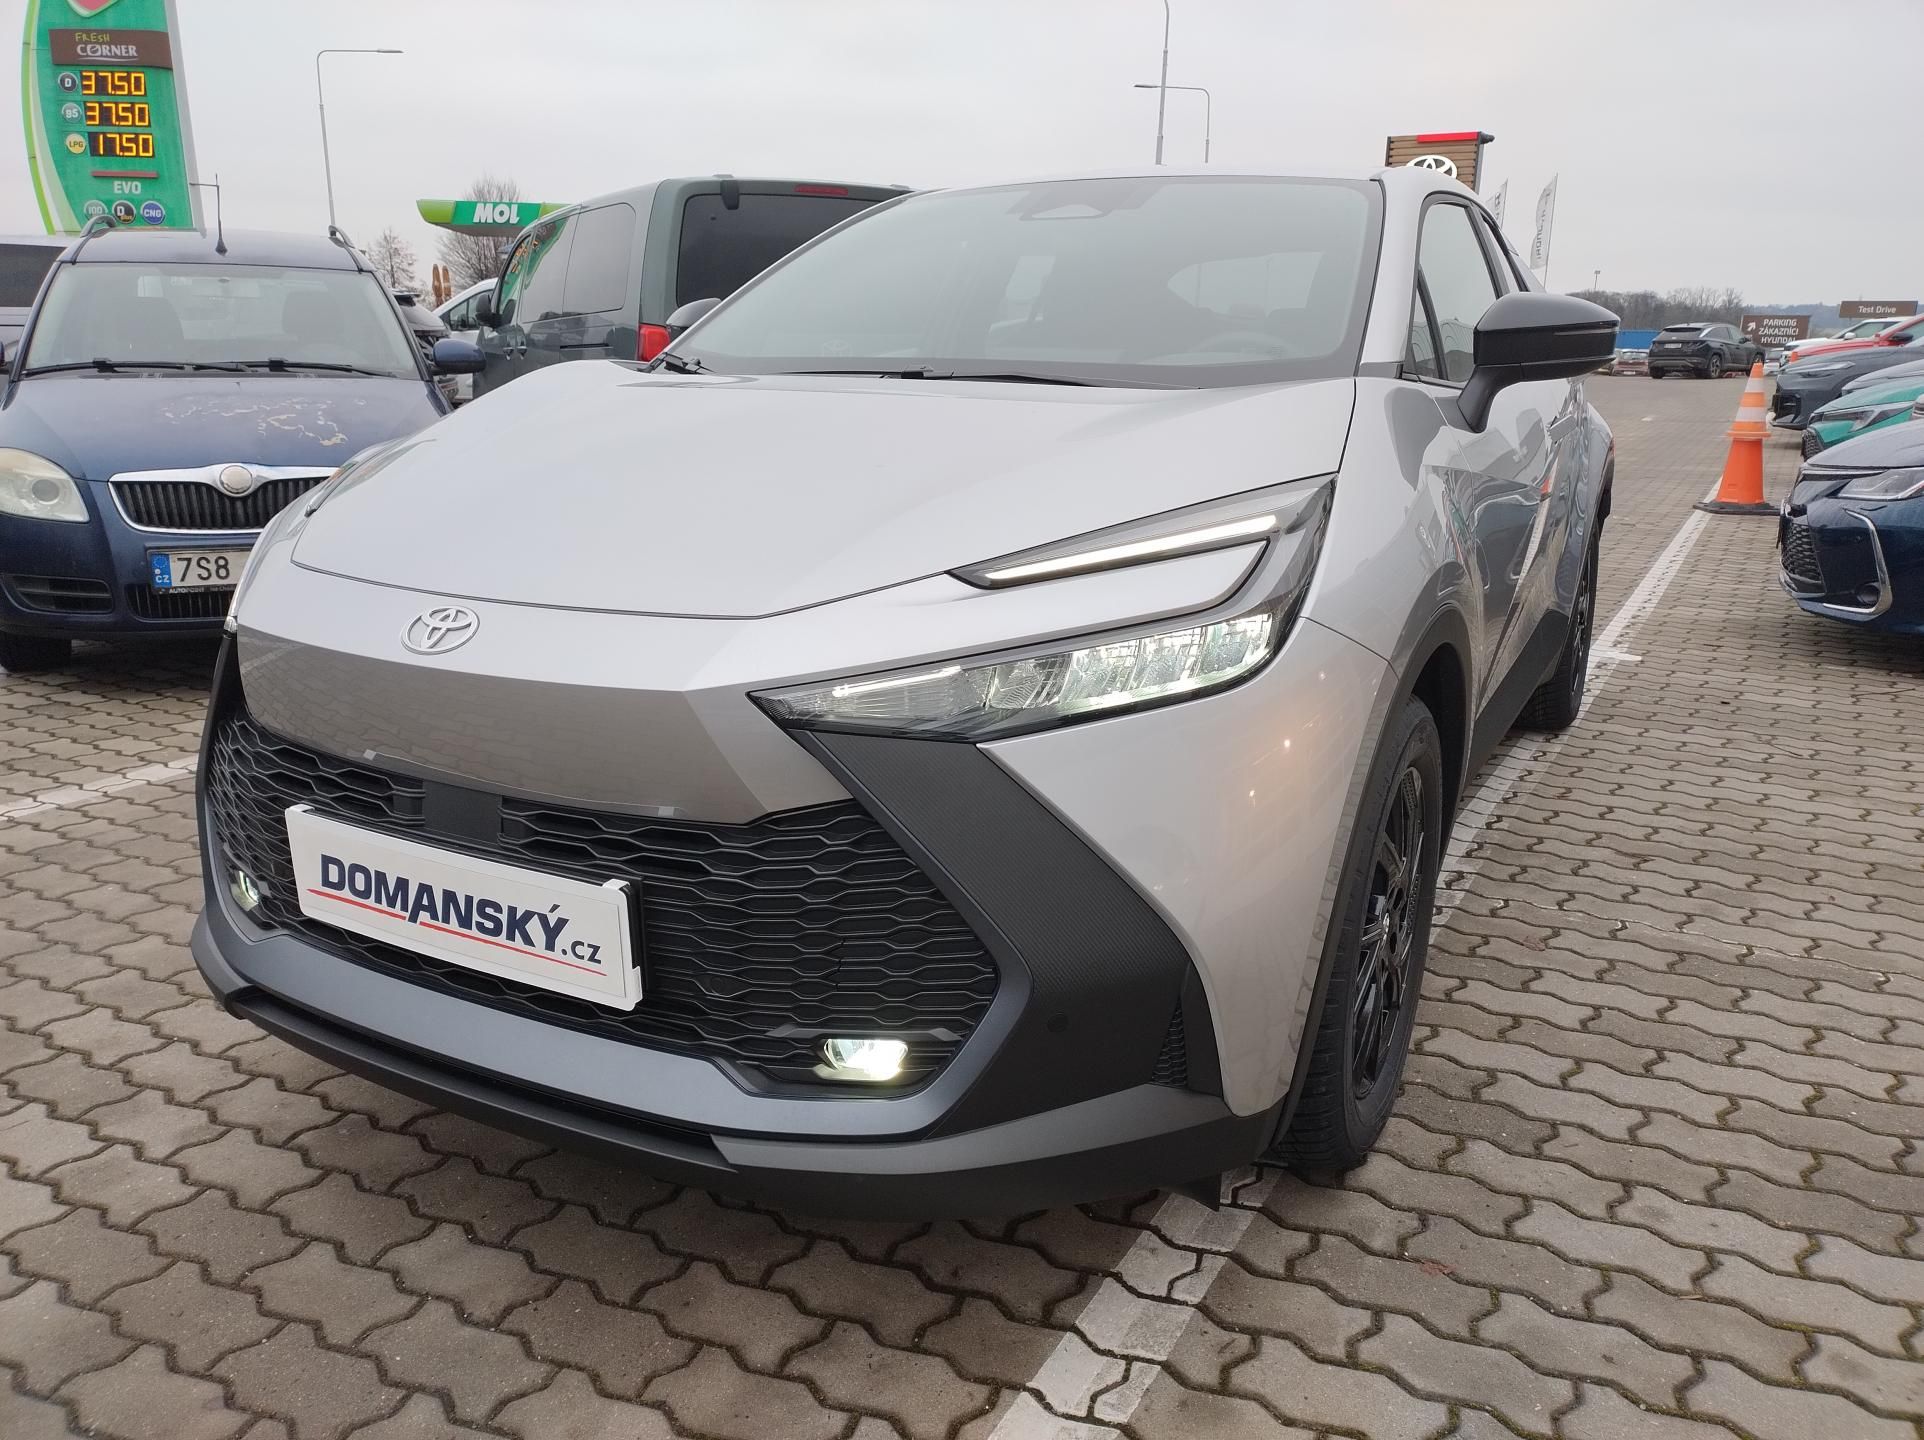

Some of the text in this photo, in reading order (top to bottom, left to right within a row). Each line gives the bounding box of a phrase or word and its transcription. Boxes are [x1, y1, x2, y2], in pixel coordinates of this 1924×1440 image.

[75, 32, 110, 43] FRESH
[76, 44, 138, 57] CORNER
[64, 71, 146, 95] D 37.50
[65, 102, 150, 126] 95 37.50
[69, 133, 153, 157] LPG 17.50
[113, 181, 141, 194] EVO
[116, 205, 125, 217] D
[143, 208, 162, 218] CNG
[473, 202, 520, 224] MOL
[1858, 305, 1896, 314] Test Drive
[1763, 318, 1798, 327] PARKING
[176, 555, 231, 582] 7S8
[155, 574, 170, 584] CZ
